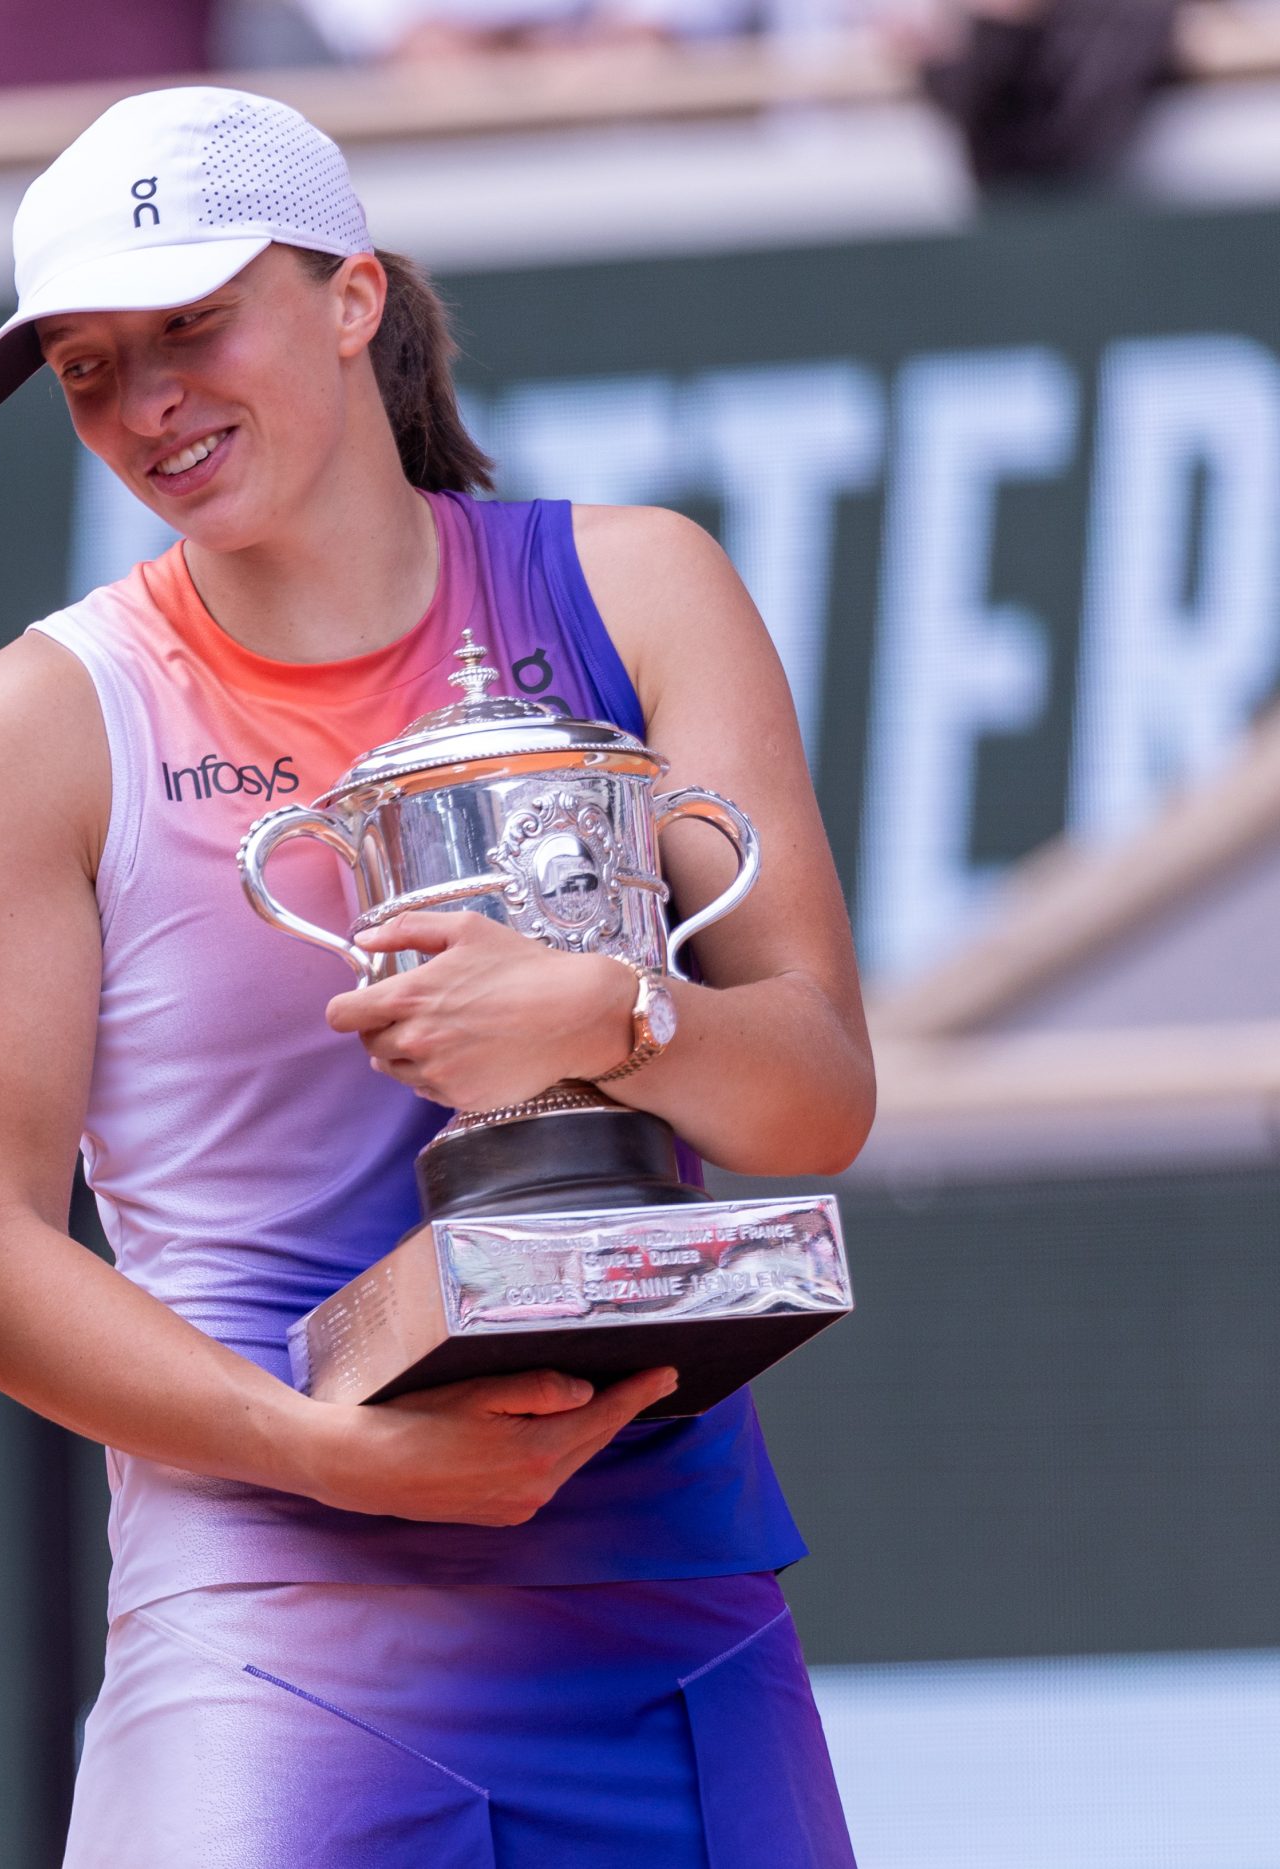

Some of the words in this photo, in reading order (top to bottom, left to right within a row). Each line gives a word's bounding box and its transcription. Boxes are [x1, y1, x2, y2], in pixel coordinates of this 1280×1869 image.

[161, 753, 300, 802] Infosys
[739, 1222, 796, 1241] FRANCE
[649, 1250, 701, 1267] DAMES
[506, 1283, 580, 1306] COUPE
[584, 1275, 685, 1302] SUZANNE
[689, 1269, 786, 1295] LENGLEN
